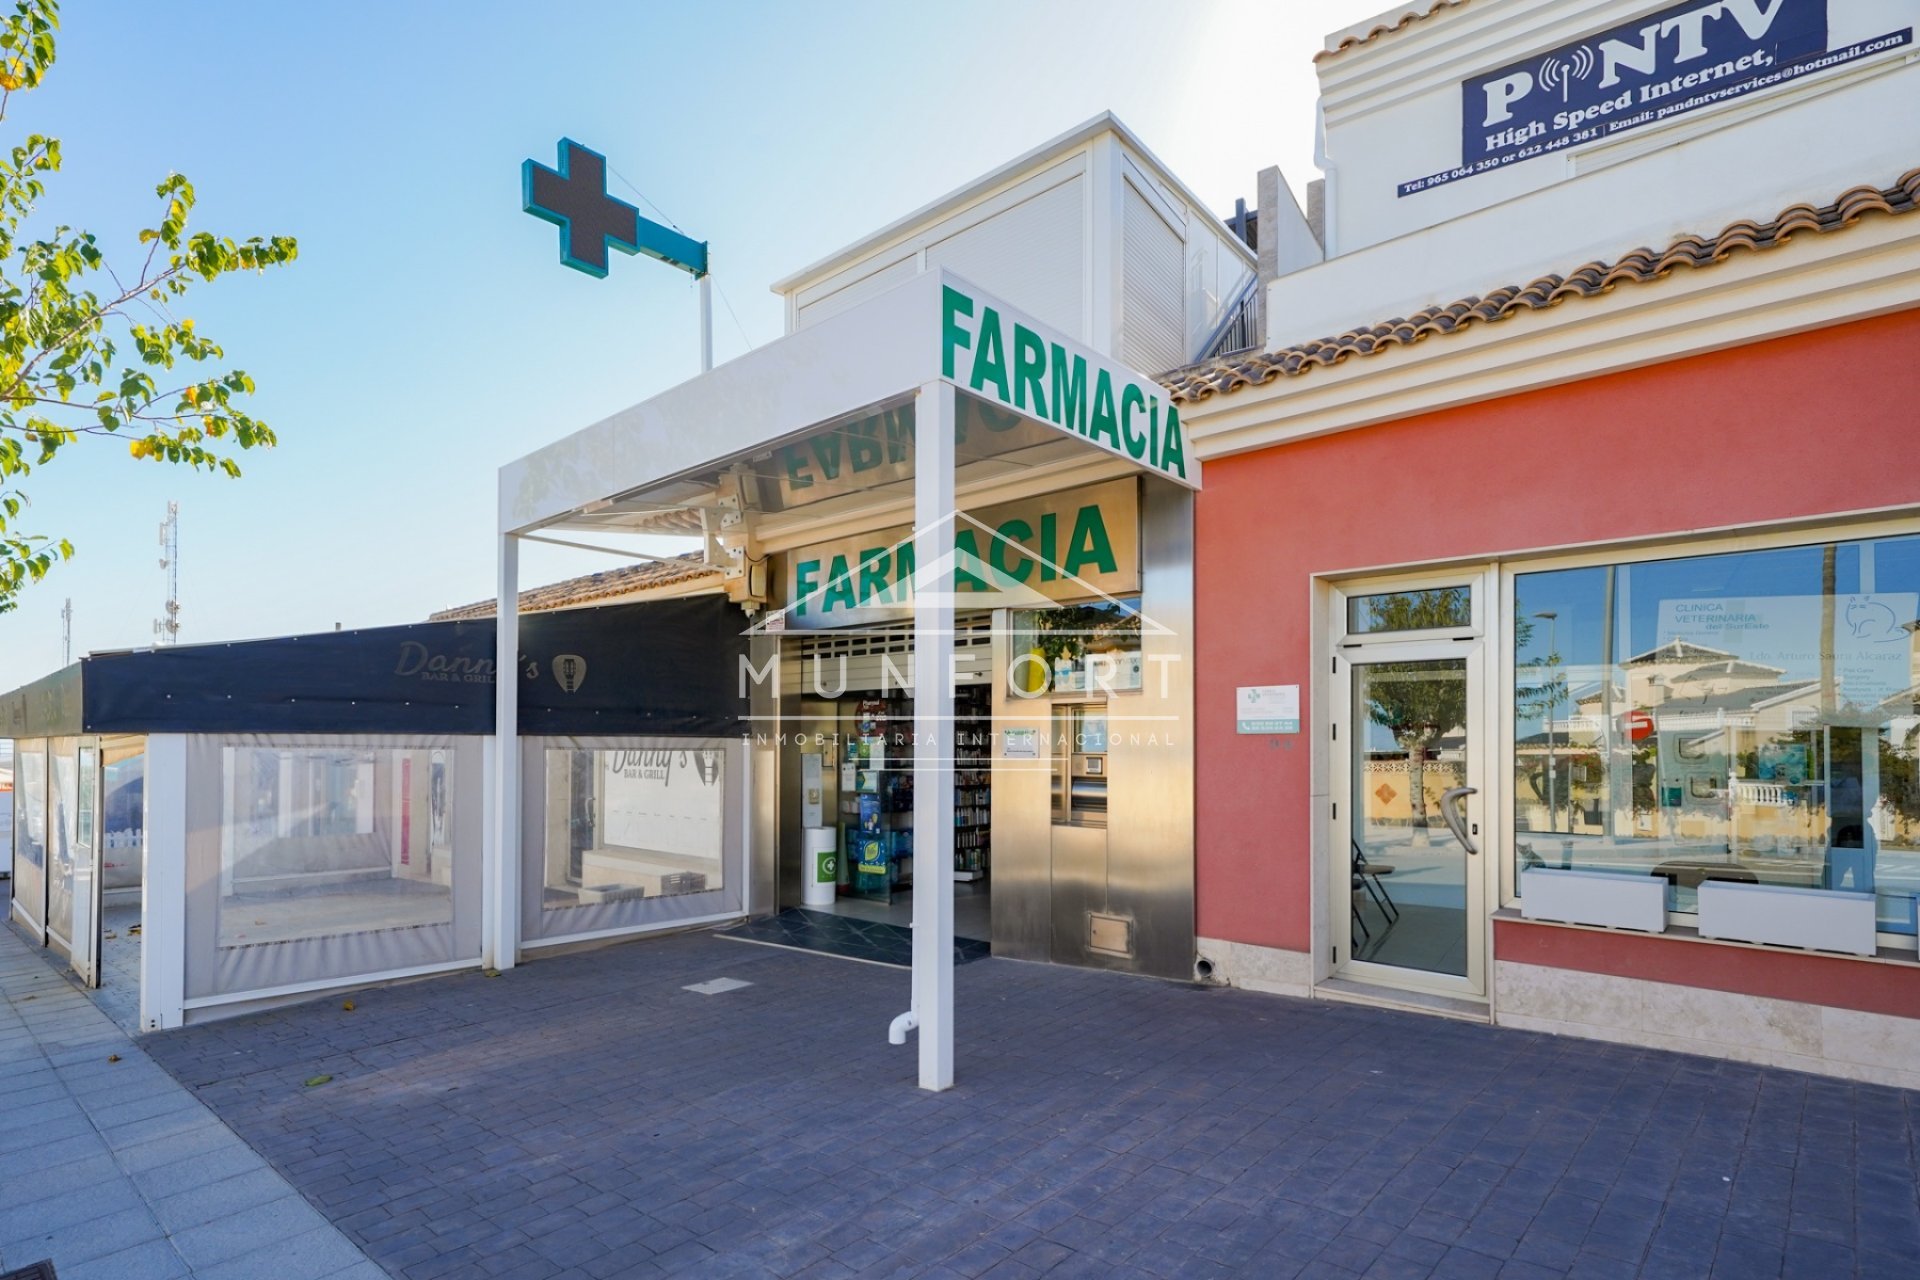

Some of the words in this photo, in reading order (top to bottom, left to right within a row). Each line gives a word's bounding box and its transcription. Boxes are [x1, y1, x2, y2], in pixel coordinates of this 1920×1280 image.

[1485, 120, 1547, 152] High
[1553, 89, 1632, 131] Speed
[1639, 48, 1774, 103] Internet,
[1404, 180, 1425, 193] Tel:
[1427, 172, 1449, 186] 965
[1451, 166, 1473, 179] 064
[1476, 158, 1500, 171] 350
[1502, 153, 1516, 163] or
[1518, 144, 1542, 158] 622
[1545, 136, 1569, 150] 448
[1573, 129, 1598, 142] 381
[1609, 111, 1654, 131] Email:
[1657, 34, 1904, 118] pandntvservices@hotmail.com
[942, 284, 1186, 480] FARMACIA
[1675, 603, 1724, 613] CLINICA
[1675, 613, 1757, 623] VETERINARIA
[421, 671, 449, 682] BAR
[464, 675, 496, 684] GRIL
[624, 768, 636, 779] BAR
[643, 769, 665, 780] GRILL
